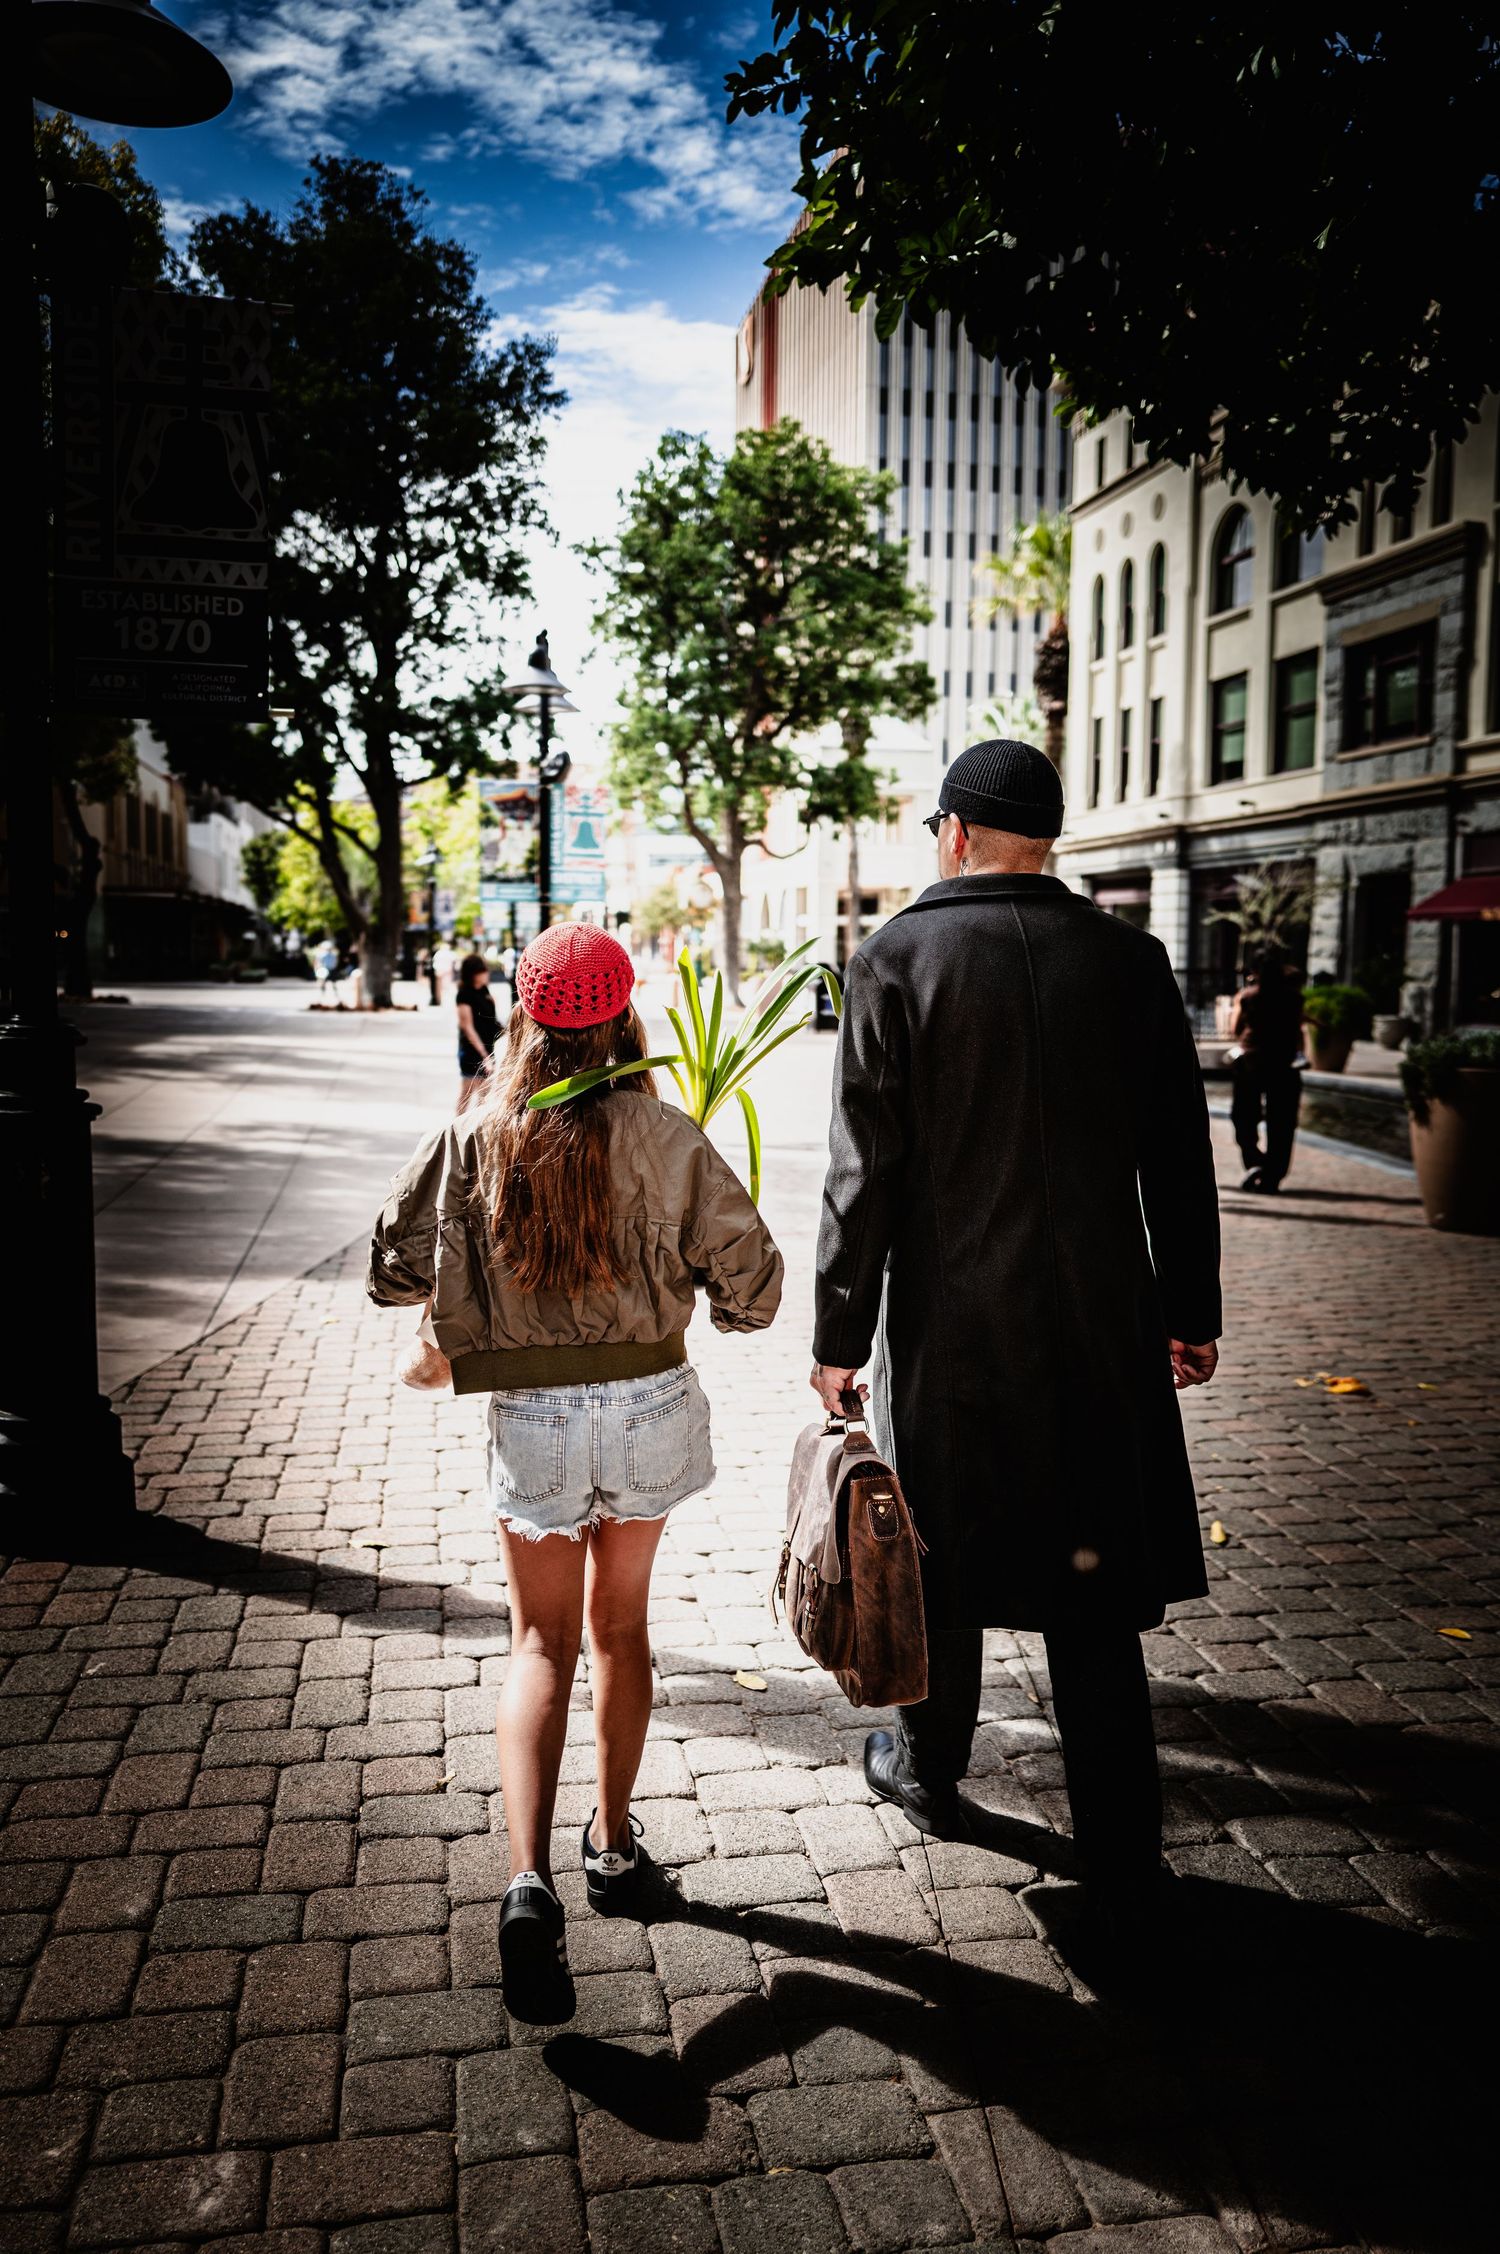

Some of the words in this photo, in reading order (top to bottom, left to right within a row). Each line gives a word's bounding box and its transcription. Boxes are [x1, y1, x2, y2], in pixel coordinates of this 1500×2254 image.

[63, 303, 102, 563] RIVERSIDE
[80, 589, 245, 617] ESTABLISHED
[113, 616, 212, 654] 1870
[176, 681, 233, 694] CALIFORNIA
[181, 673, 238, 685] DESIGNATED
[161, 691, 207, 703] CULTURAL
[209, 693, 248, 704] DISTRICT
